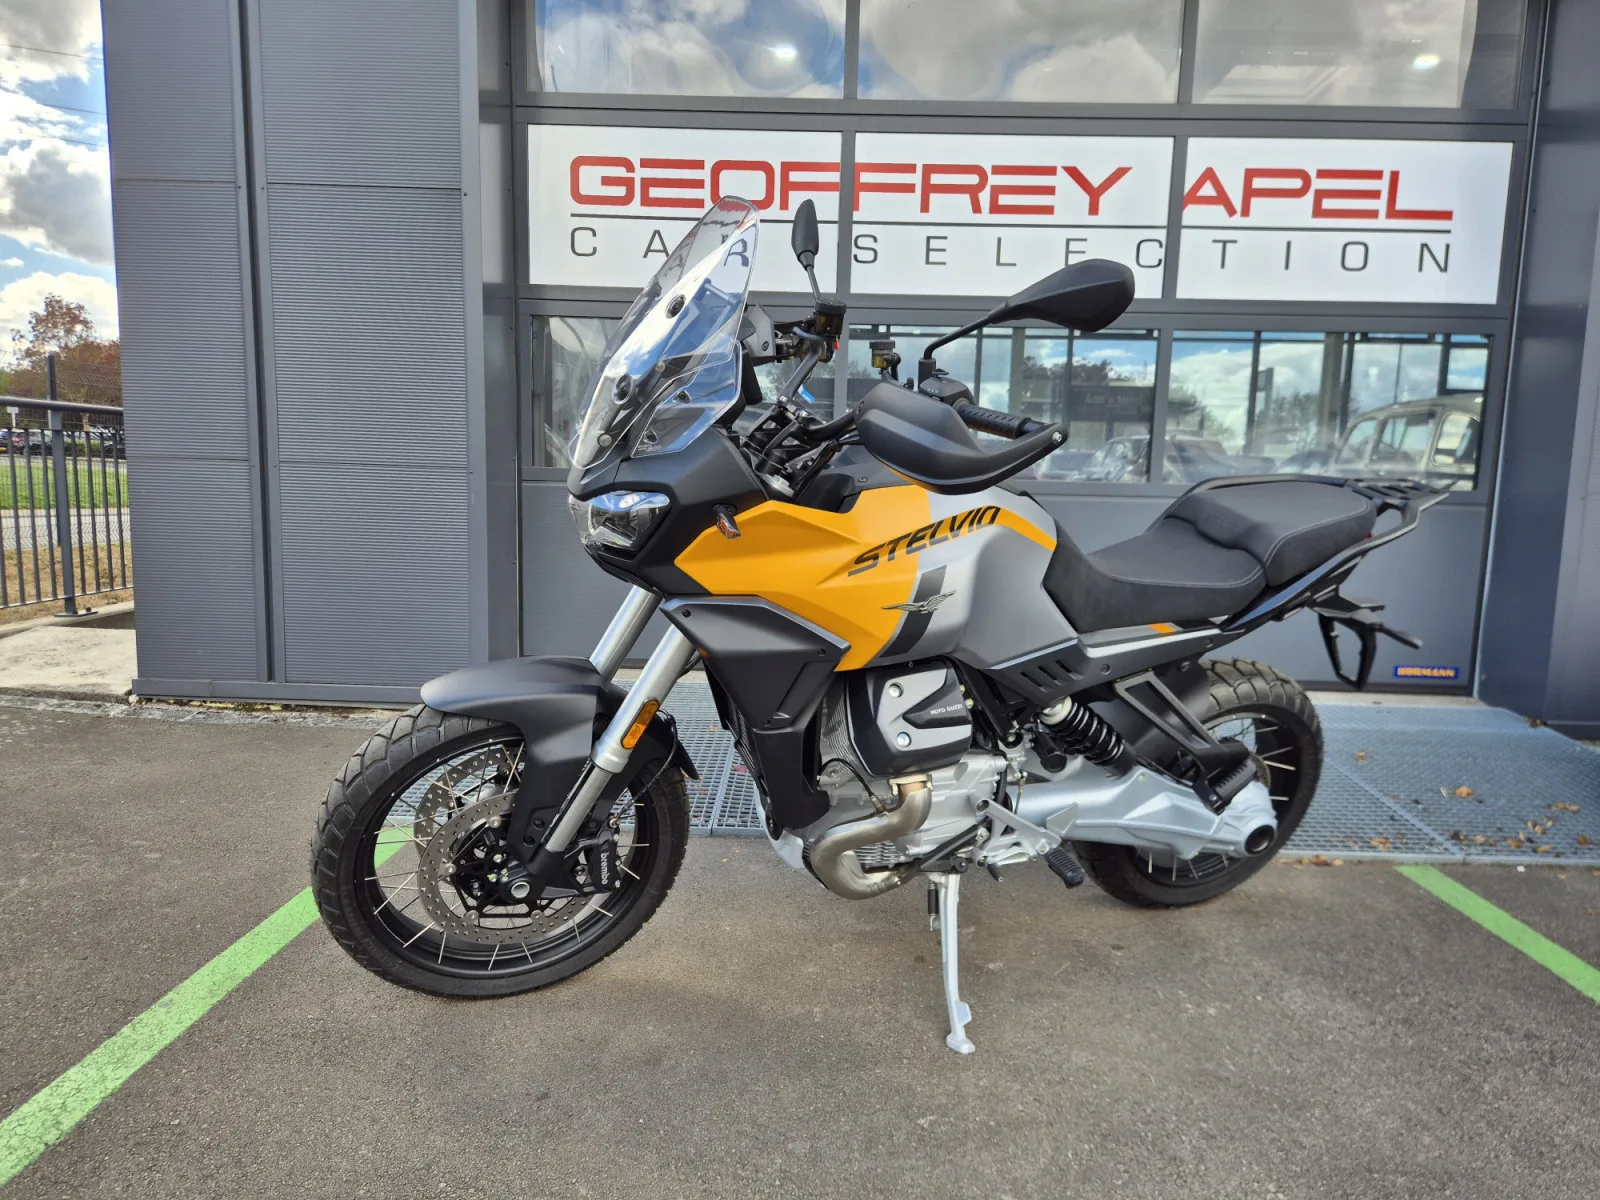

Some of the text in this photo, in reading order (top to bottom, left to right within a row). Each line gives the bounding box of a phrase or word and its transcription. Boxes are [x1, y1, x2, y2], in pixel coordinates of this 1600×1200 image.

[569, 155, 1454, 220] GEOFFREY APEL
[569, 226, 1451, 274] CAR SELECTION
[847, 505, 1002, 577] STELVIO
[930, 707, 946, 715] MOTO
[600, 852, 610, 885] brembo
